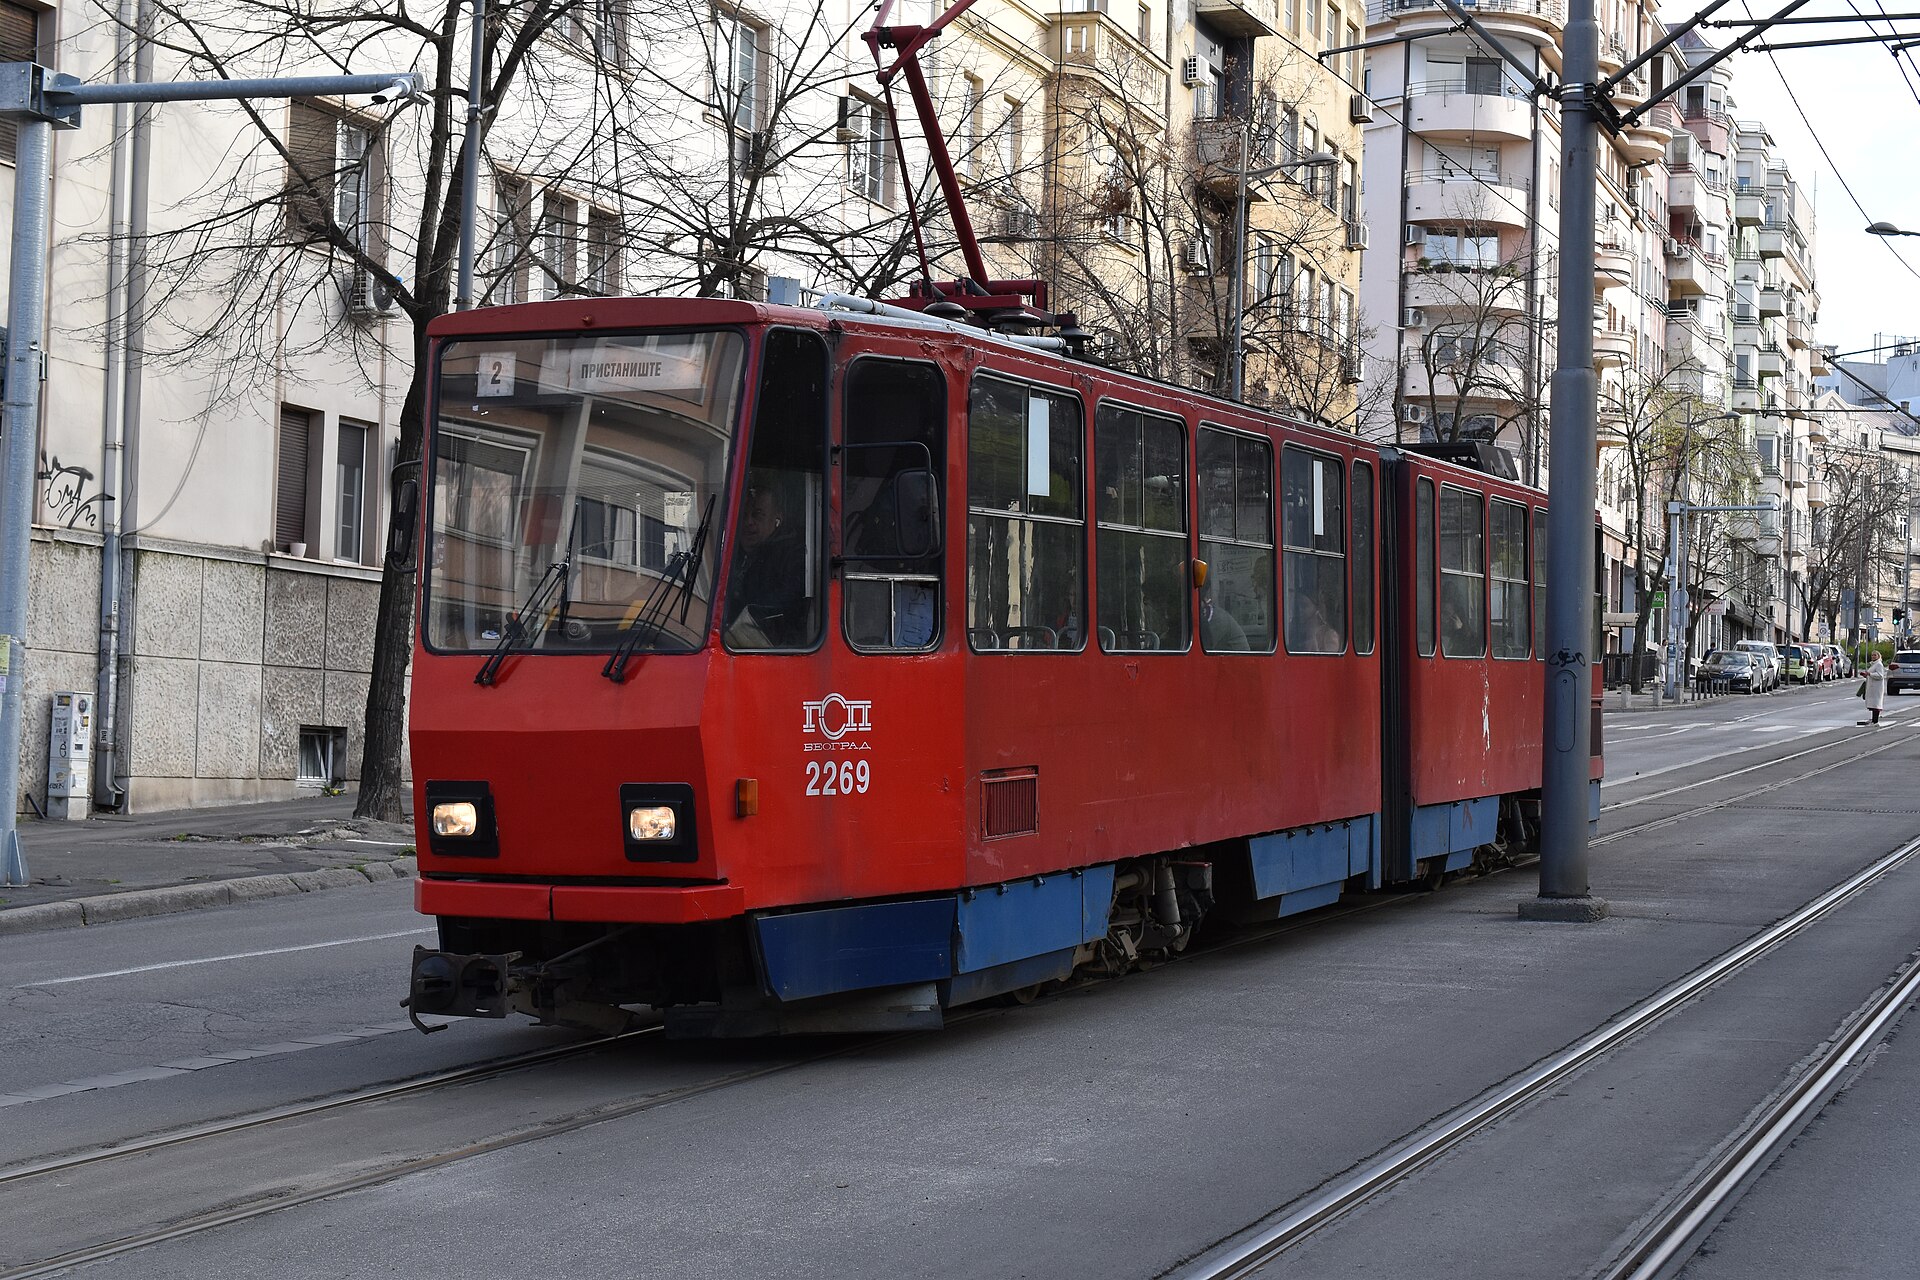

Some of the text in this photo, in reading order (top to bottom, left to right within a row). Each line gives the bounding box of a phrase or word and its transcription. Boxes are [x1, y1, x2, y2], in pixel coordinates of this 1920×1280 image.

[491, 361, 502, 385] 2
[581, 362, 662, 379] ПРИСТАНИШТЕ
[803, 692, 872, 740] ГСП
[803, 741, 872, 752] БЕОГРАД
[805, 760, 870, 796] 2269
